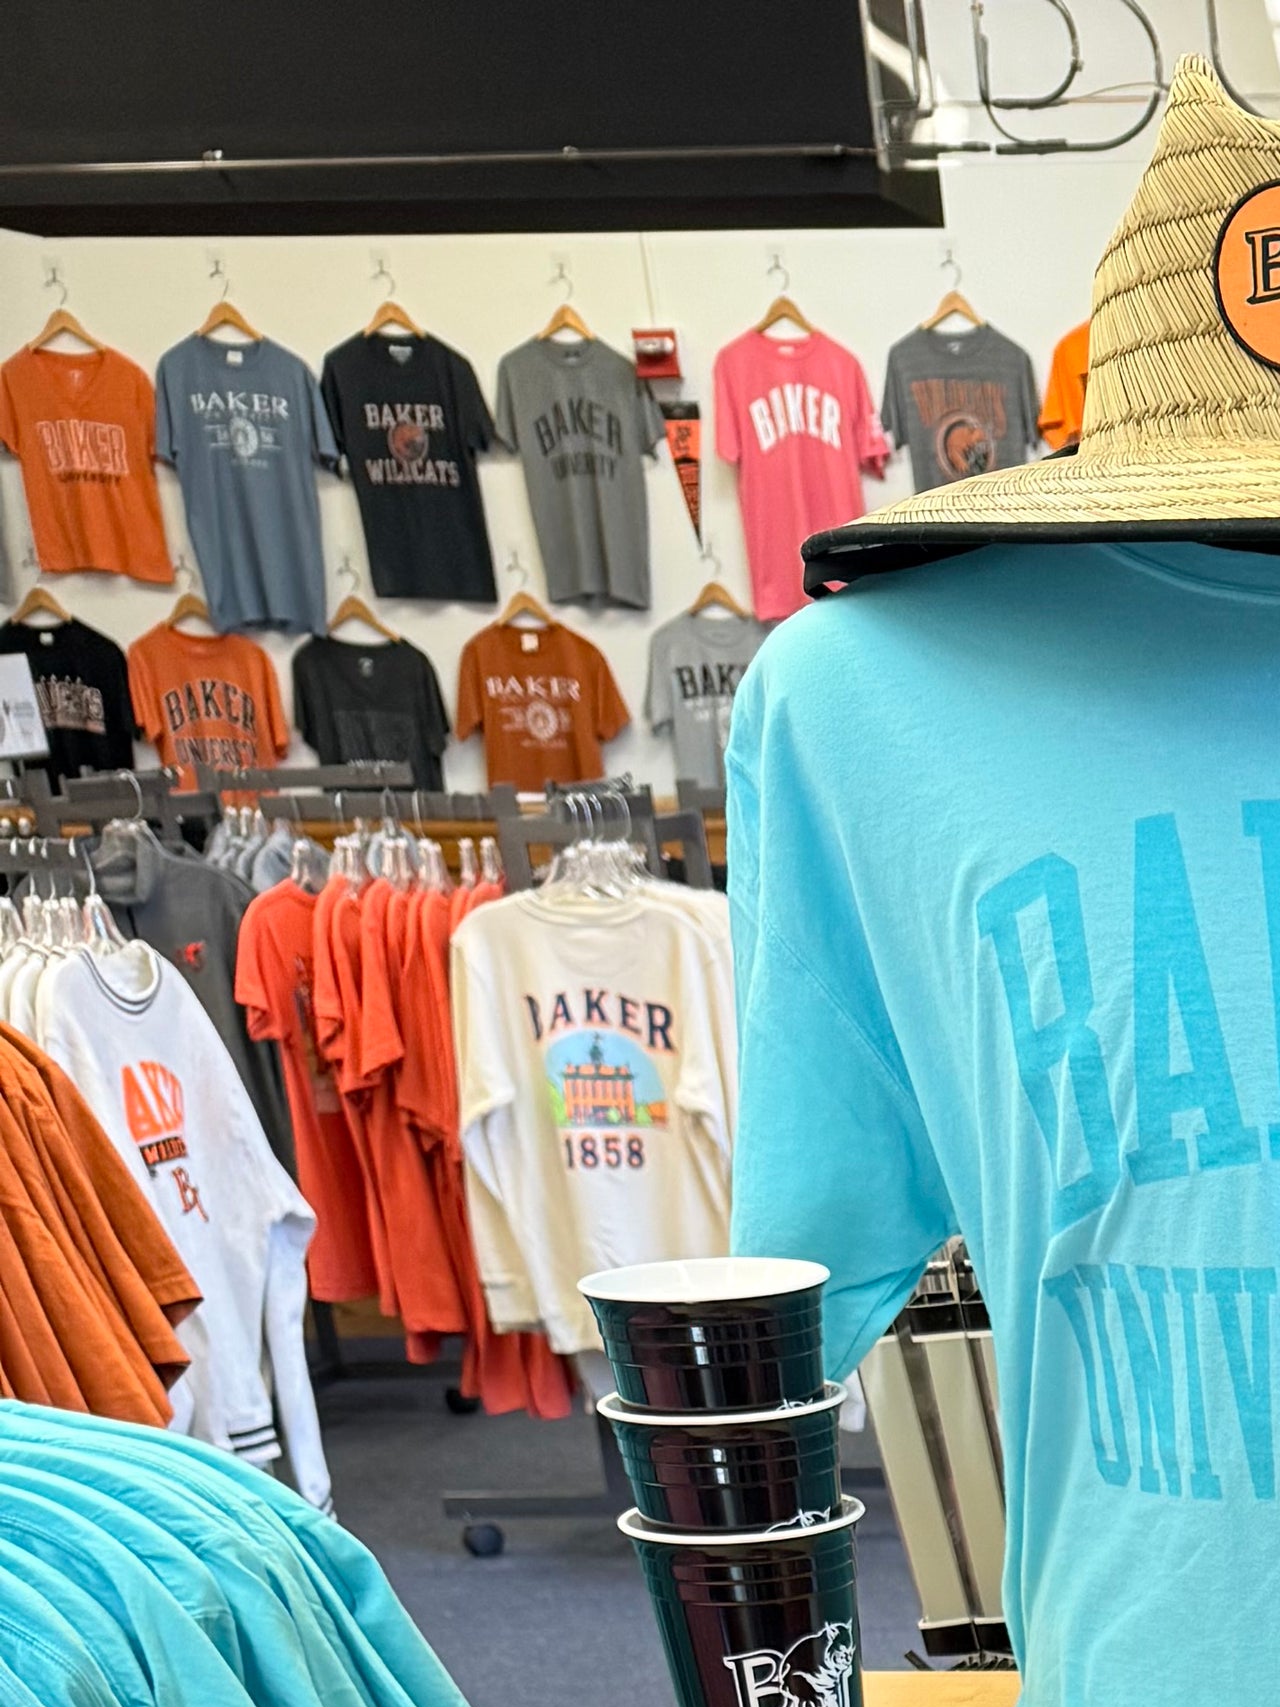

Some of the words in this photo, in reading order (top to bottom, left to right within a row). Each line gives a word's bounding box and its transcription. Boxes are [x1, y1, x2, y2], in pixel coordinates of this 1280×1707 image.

[190, 389, 289, 420] BAKER
[364, 402, 445, 430] BAKER
[535, 399, 623, 456] BAKER
[36, 419, 129, 476] BAKER
[365, 458, 461, 487] WILDCATS
[676, 663, 745, 699] BAK
[162, 679, 258, 737] BAKER
[524, 988, 675, 1052] BAKER
[565, 1136, 645, 1170] 1858
